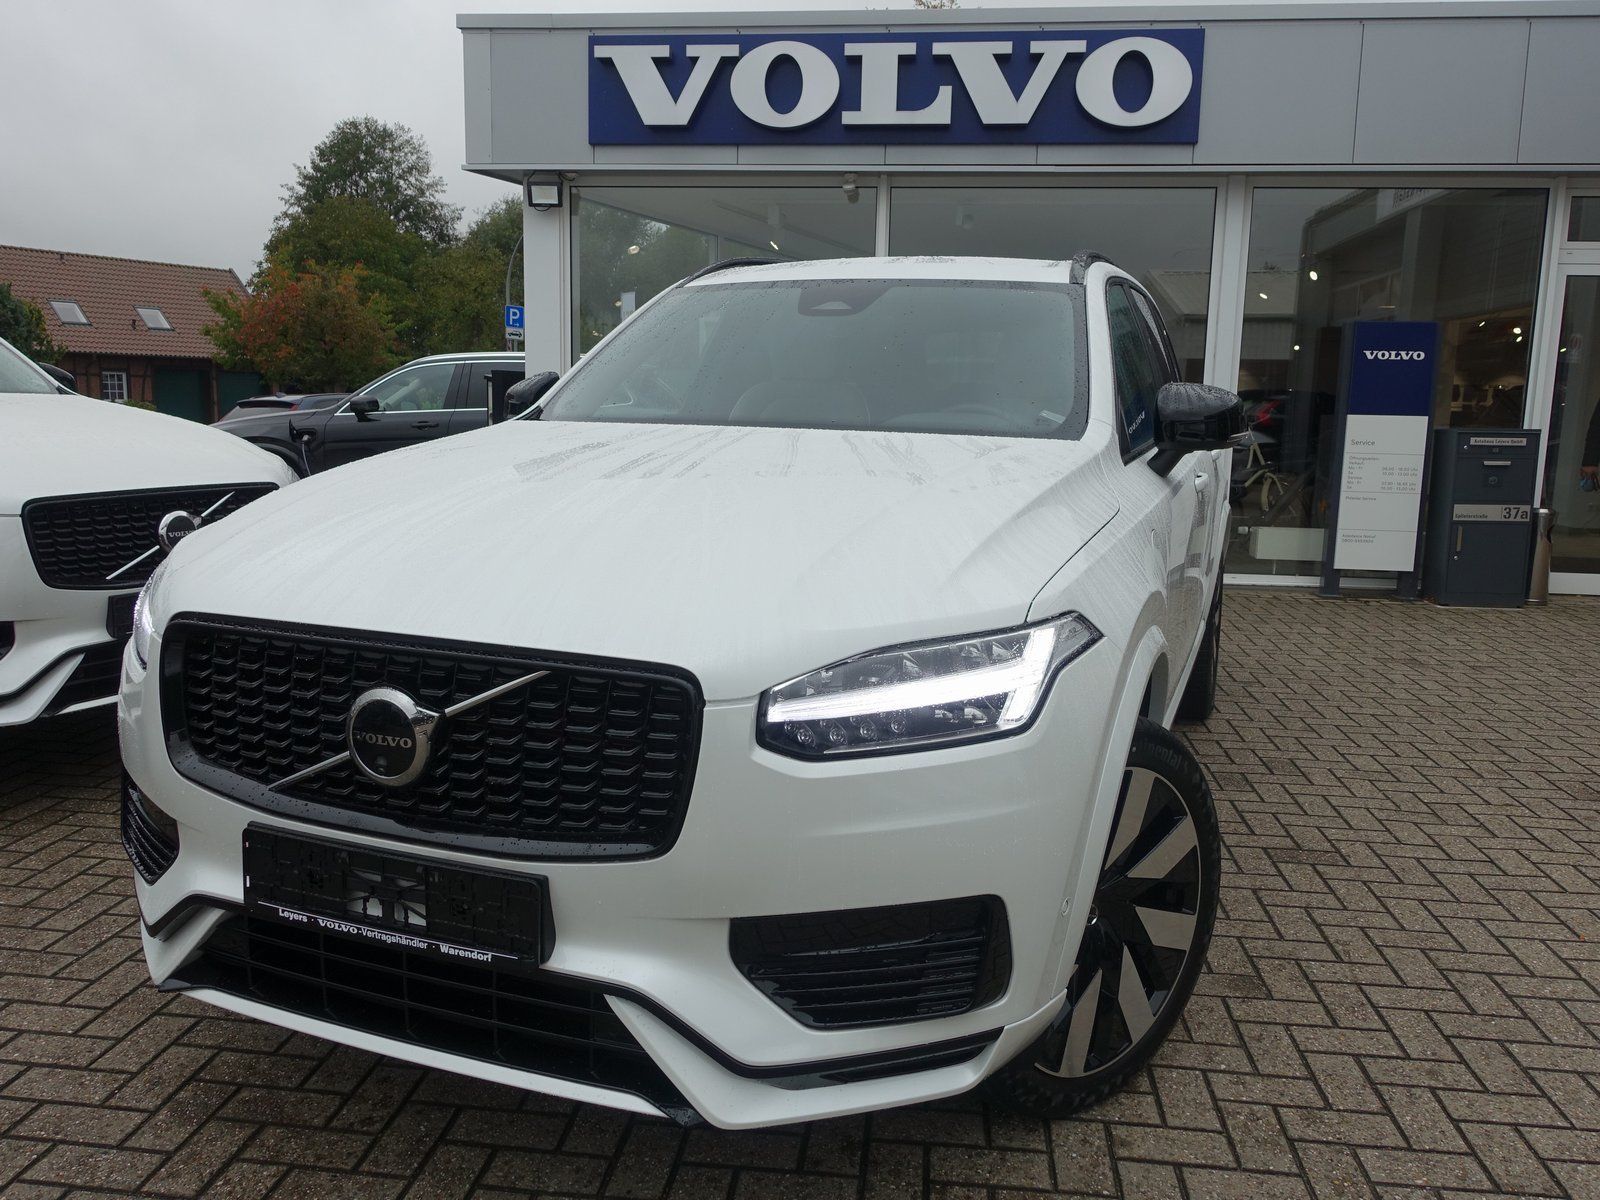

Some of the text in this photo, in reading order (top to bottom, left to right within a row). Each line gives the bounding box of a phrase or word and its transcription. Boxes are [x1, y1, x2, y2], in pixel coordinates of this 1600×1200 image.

[593, 36, 1193, 128] VOLVO
[509, 308, 520, 325] P
[1363, 350, 1425, 361] VOLVO
[1503, 506, 1529, 520] 37a
[353, 730, 413, 749] VOLVO
[279, 908, 308, 923] Leyers
[440, 943, 493, 962] Warendorf
